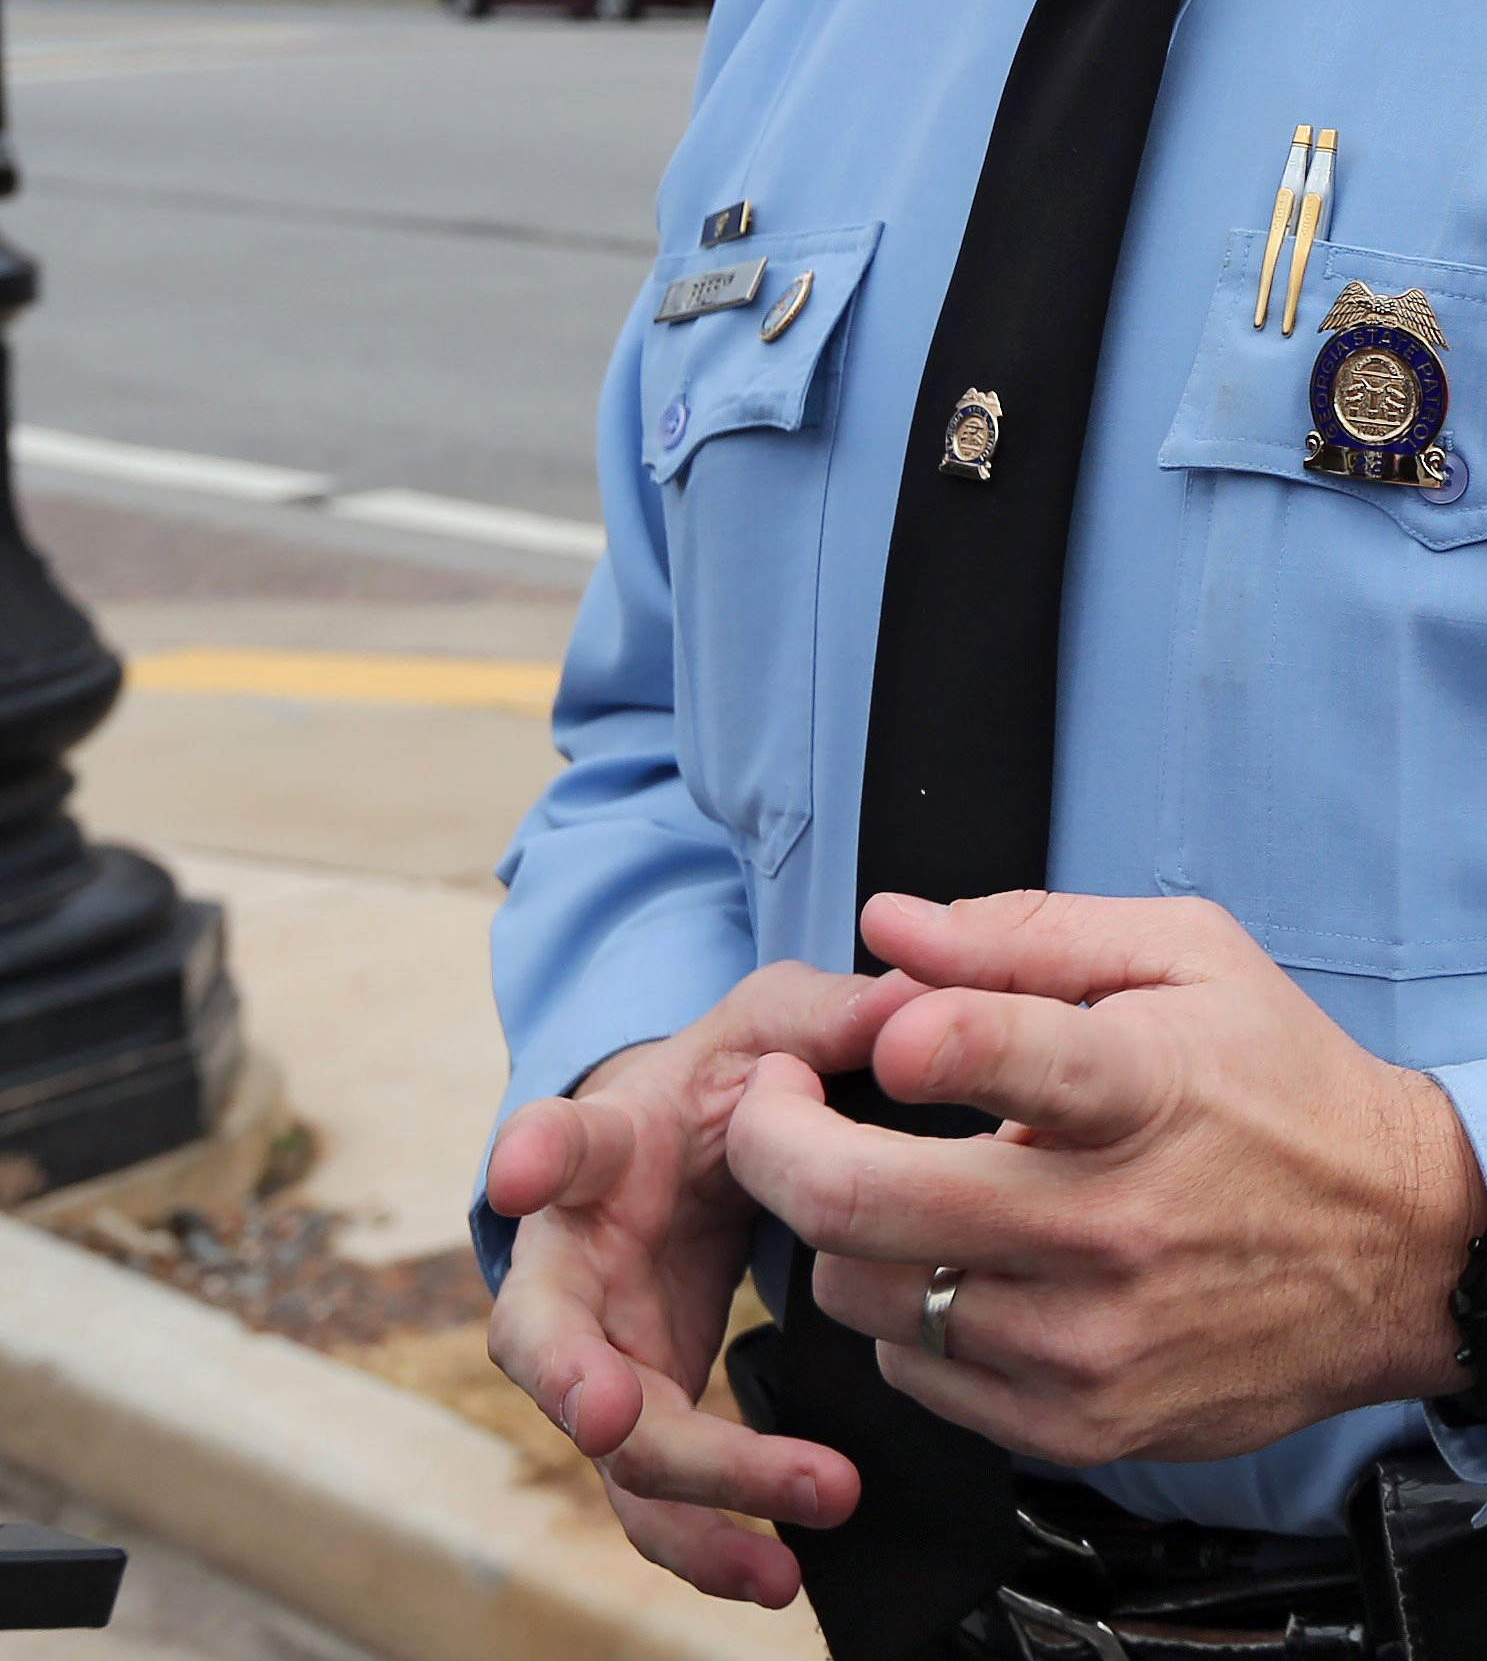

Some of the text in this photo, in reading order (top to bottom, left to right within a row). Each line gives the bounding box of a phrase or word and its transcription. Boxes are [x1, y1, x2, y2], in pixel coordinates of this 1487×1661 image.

[1316, 327, 1442, 449] GEORGIA STATE PATROL
